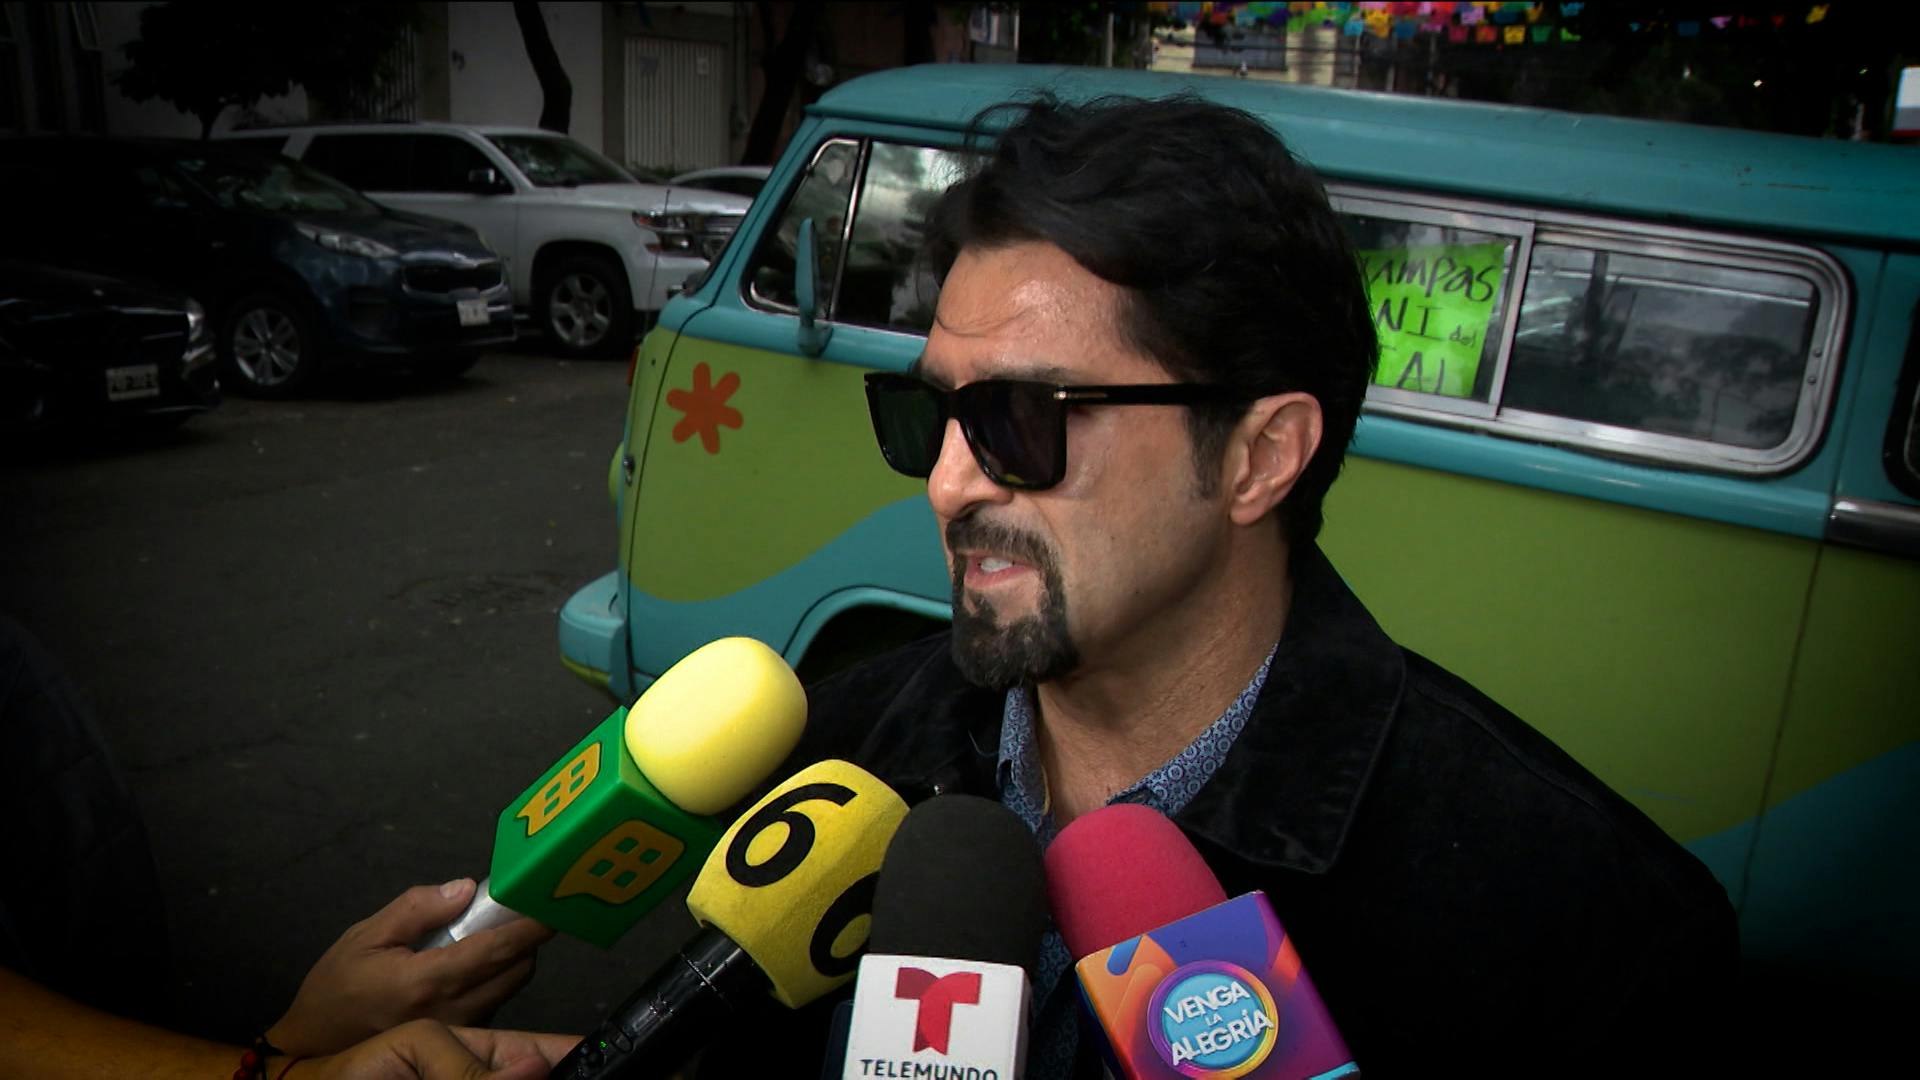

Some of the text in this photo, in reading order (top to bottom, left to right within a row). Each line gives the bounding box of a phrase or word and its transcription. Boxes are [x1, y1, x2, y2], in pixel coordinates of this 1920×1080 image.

[726, 783, 858, 887] 6
[1163, 981, 1250, 1024] VENGA
[1204, 1013, 1223, 1027] LA
[1171, 1008, 1274, 1066] ALEGRÍA
[859, 1058, 998, 1080] TELEMUNDO
